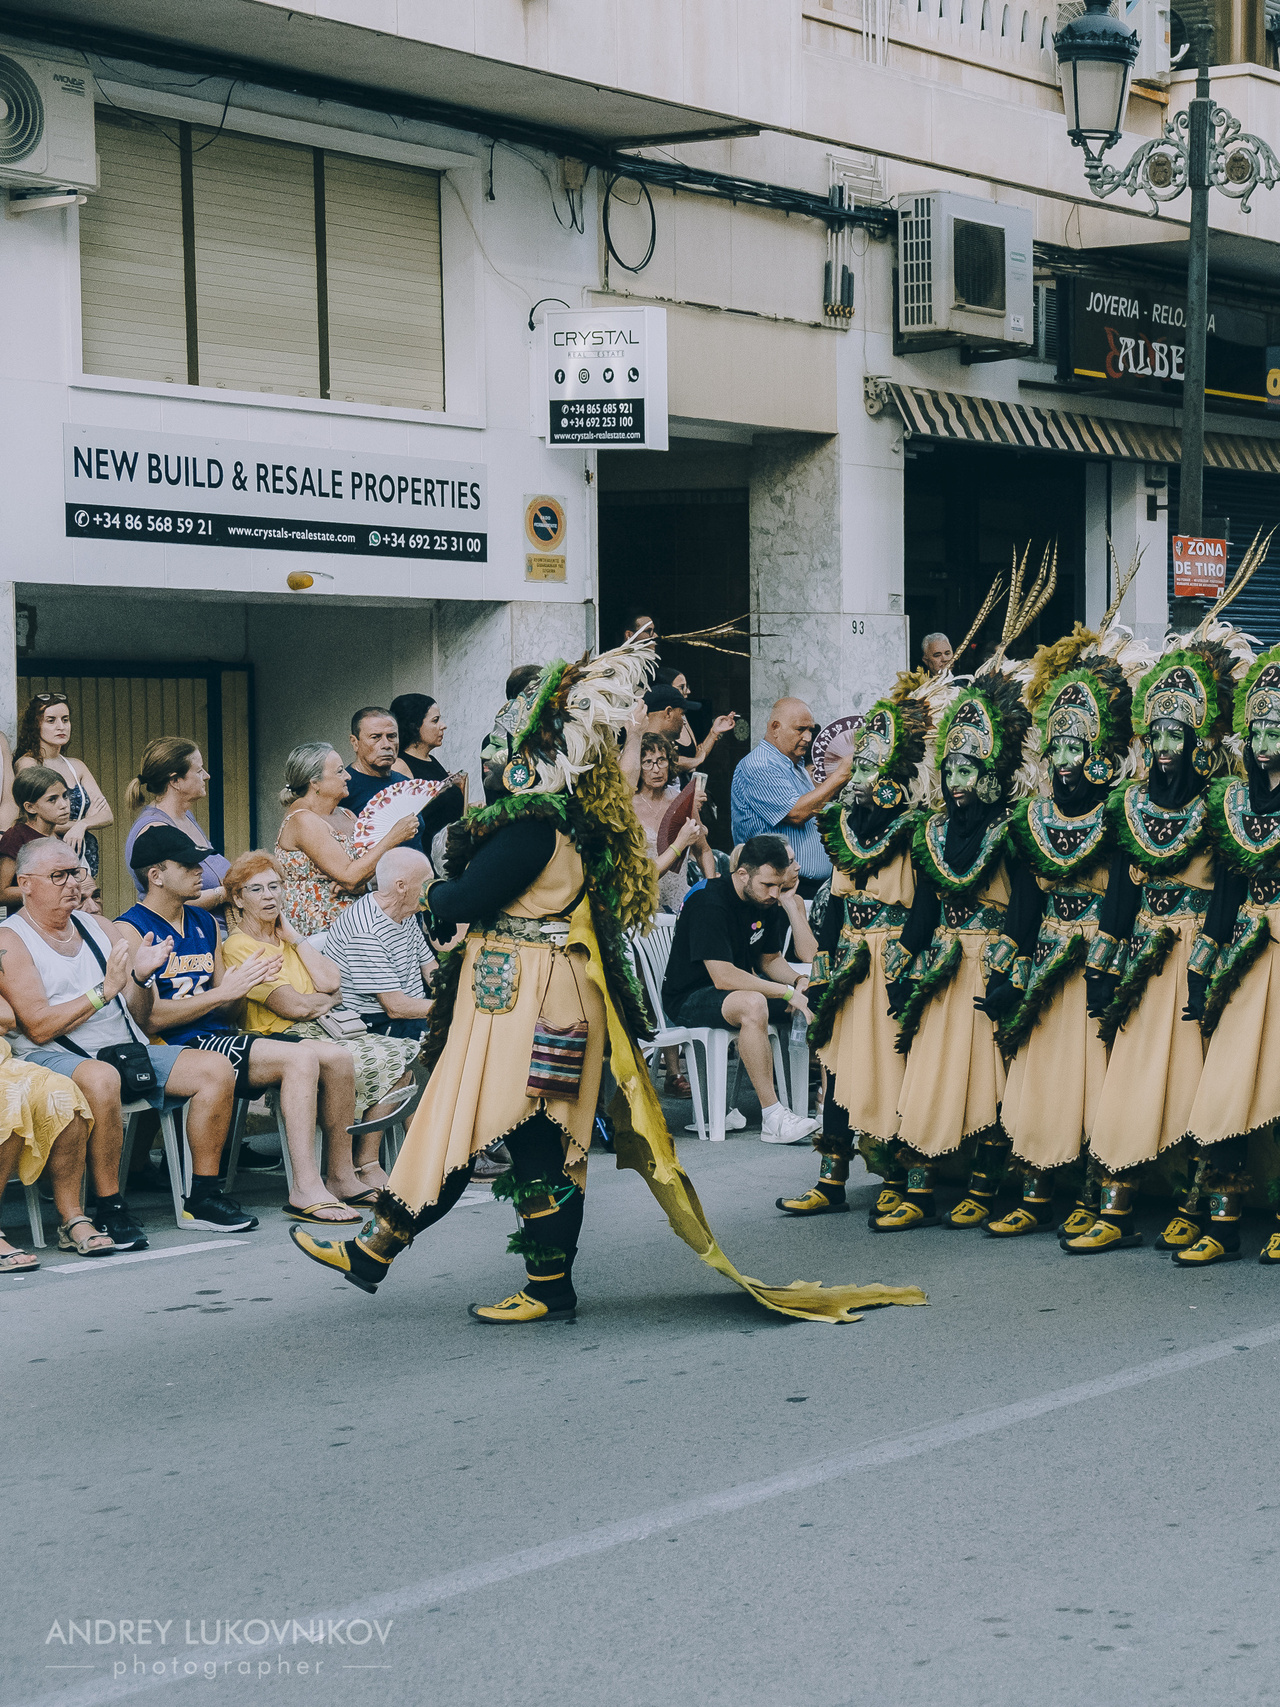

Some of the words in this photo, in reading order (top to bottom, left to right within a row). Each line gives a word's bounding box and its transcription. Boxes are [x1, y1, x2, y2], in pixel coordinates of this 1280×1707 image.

[1086, 291, 1140, 320] JOYERIA
[1152, 303, 1216, 333] RELOA
[553, 330, 640, 346] CRYSTAL
[597, 350, 625, 358] ESTATE
[1118, 336, 1186, 381] ALBE
[570, 404, 585, 414] +34
[586, 404, 601, 414] 865
[603, 403, 617, 414] 685
[619, 403, 633, 414] 921
[569, 418, 585, 428] +34
[586, 418, 600, 427] 692
[602, 417, 617, 427] 253
[620, 416, 633, 427] 100
[553, 431, 641, 442] www.crystals-realestate.com
[73, 446, 140, 482] NEW
[148, 453, 224, 489] BUILD
[232, 461, 248, 491] &
[256, 463, 344, 499] RESALE
[351, 471, 481, 510] PROPERTIES
[93, 511, 121, 529] +34
[125, 514, 142, 530] 86
[147, 515, 173, 532] 568
[176, 517, 194, 534] 59
[197, 520, 212, 535] 21
[228, 525, 356, 544] www.crystals-realestate.com
[382, 532, 405, 548] +34
[409, 534, 431, 550] 692
[433, 536, 448, 551] 25
[1187, 541, 1224, 557] ZONA
[1175, 560, 1192, 575] DE
[1194, 562, 1225, 578] TIRO
[851, 620, 865, 635] 93
[159, 951, 214, 978] LAKERS
